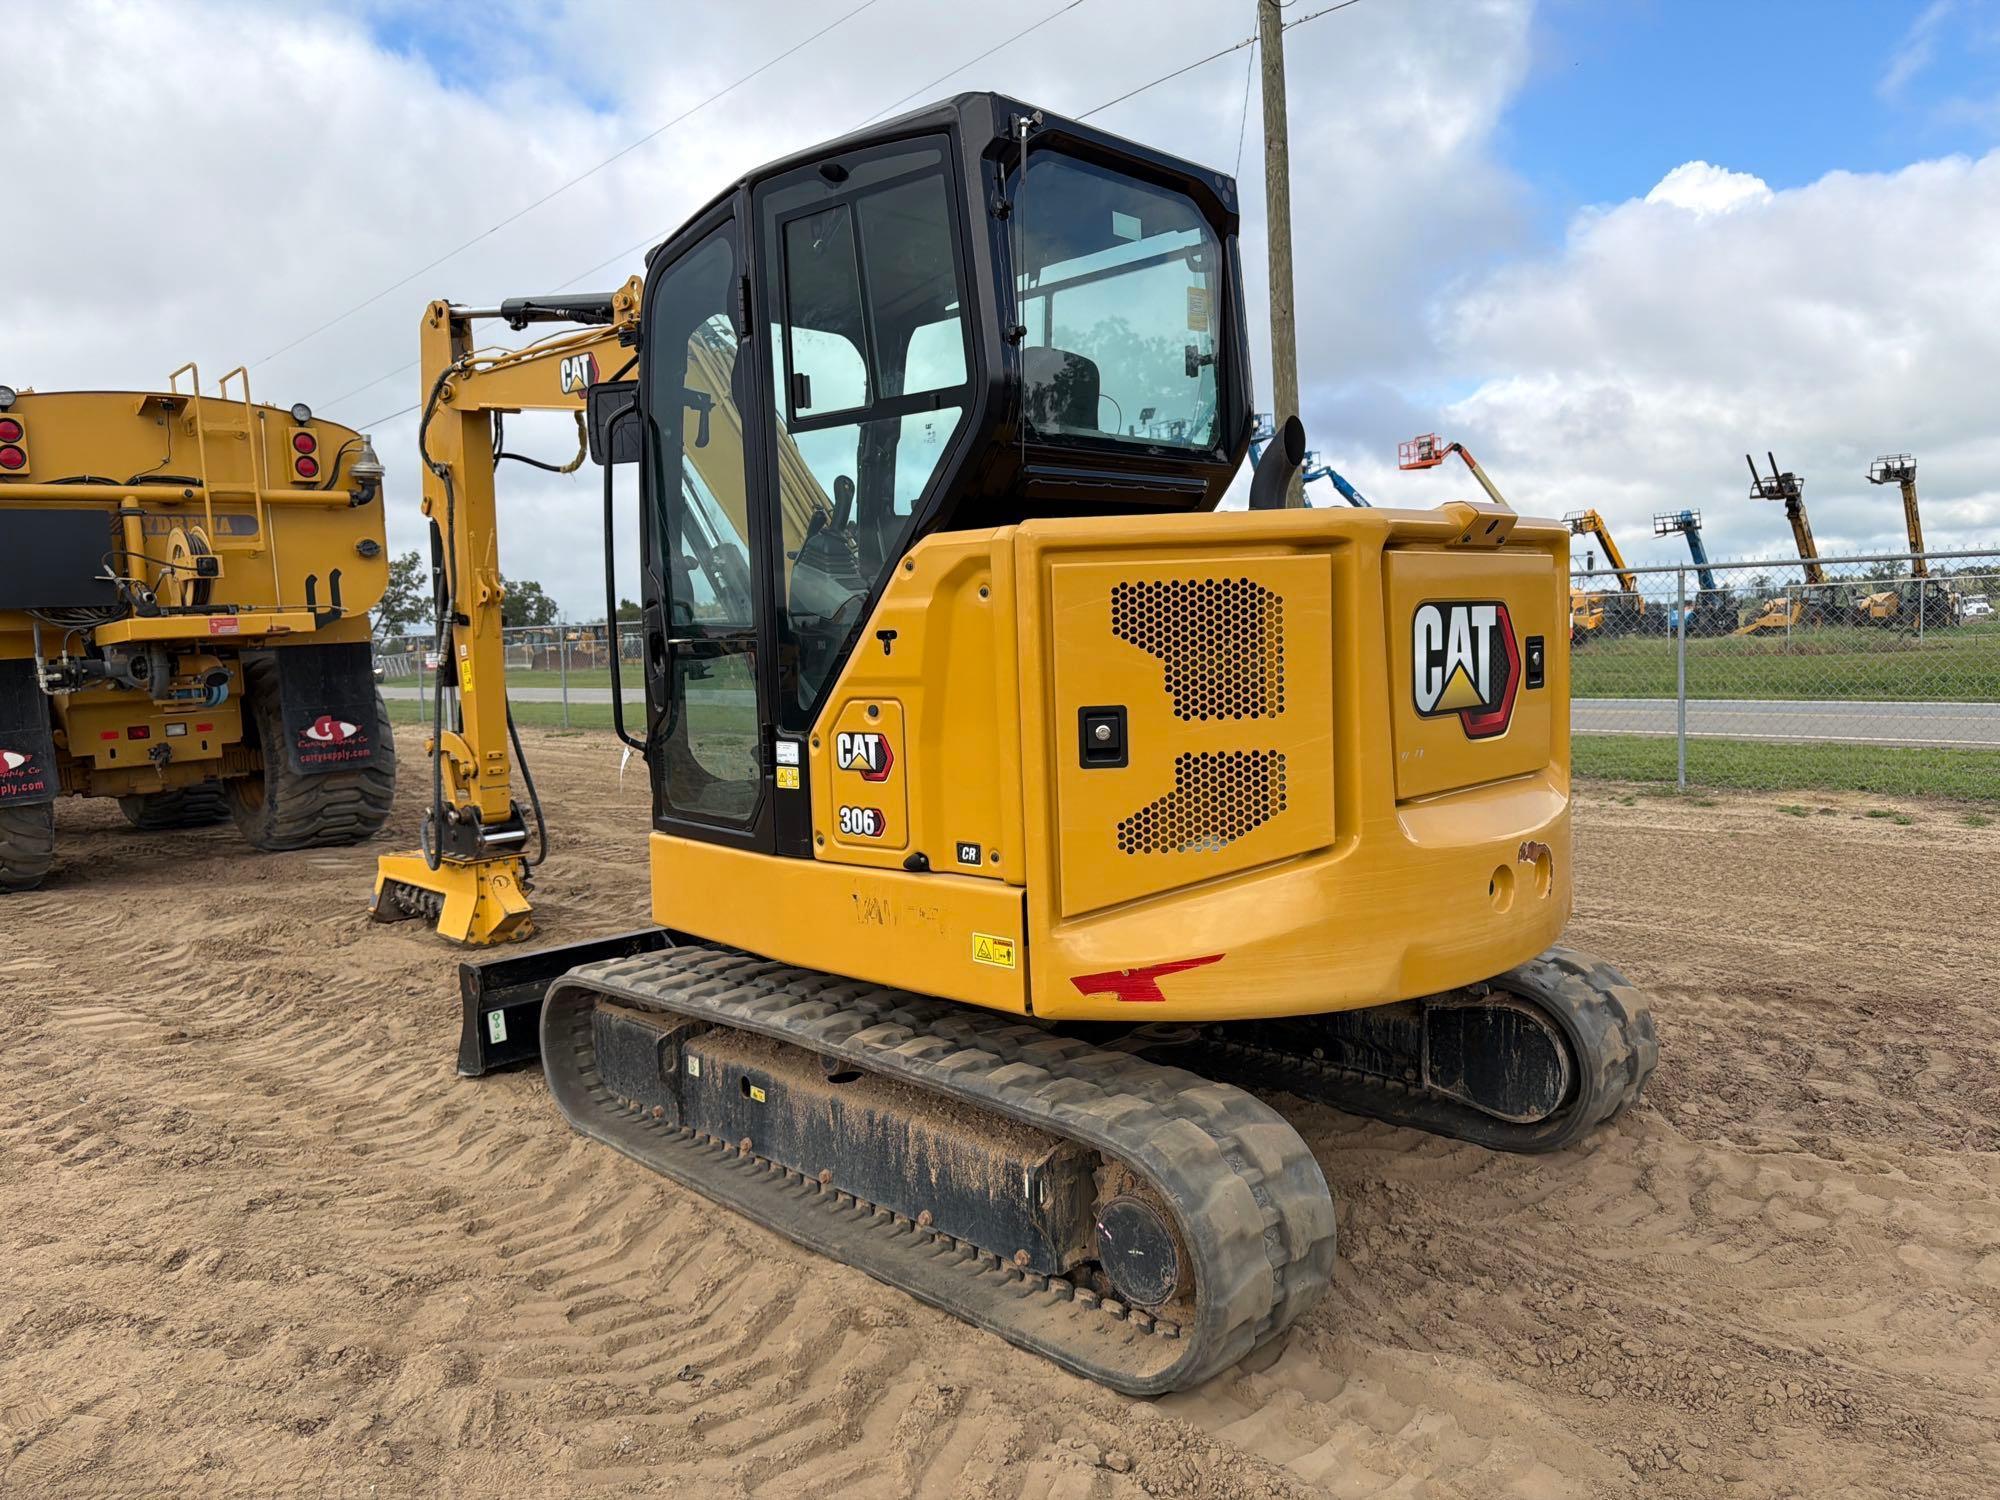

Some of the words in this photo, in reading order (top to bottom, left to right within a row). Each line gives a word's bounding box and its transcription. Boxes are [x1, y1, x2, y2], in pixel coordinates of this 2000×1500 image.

[560, 353, 590, 393] CAT
[1414, 605, 1497, 712] CAT
[837, 733, 879, 770] CAT
[840, 807, 875, 836] 306
[962, 846, 976, 860] CR
